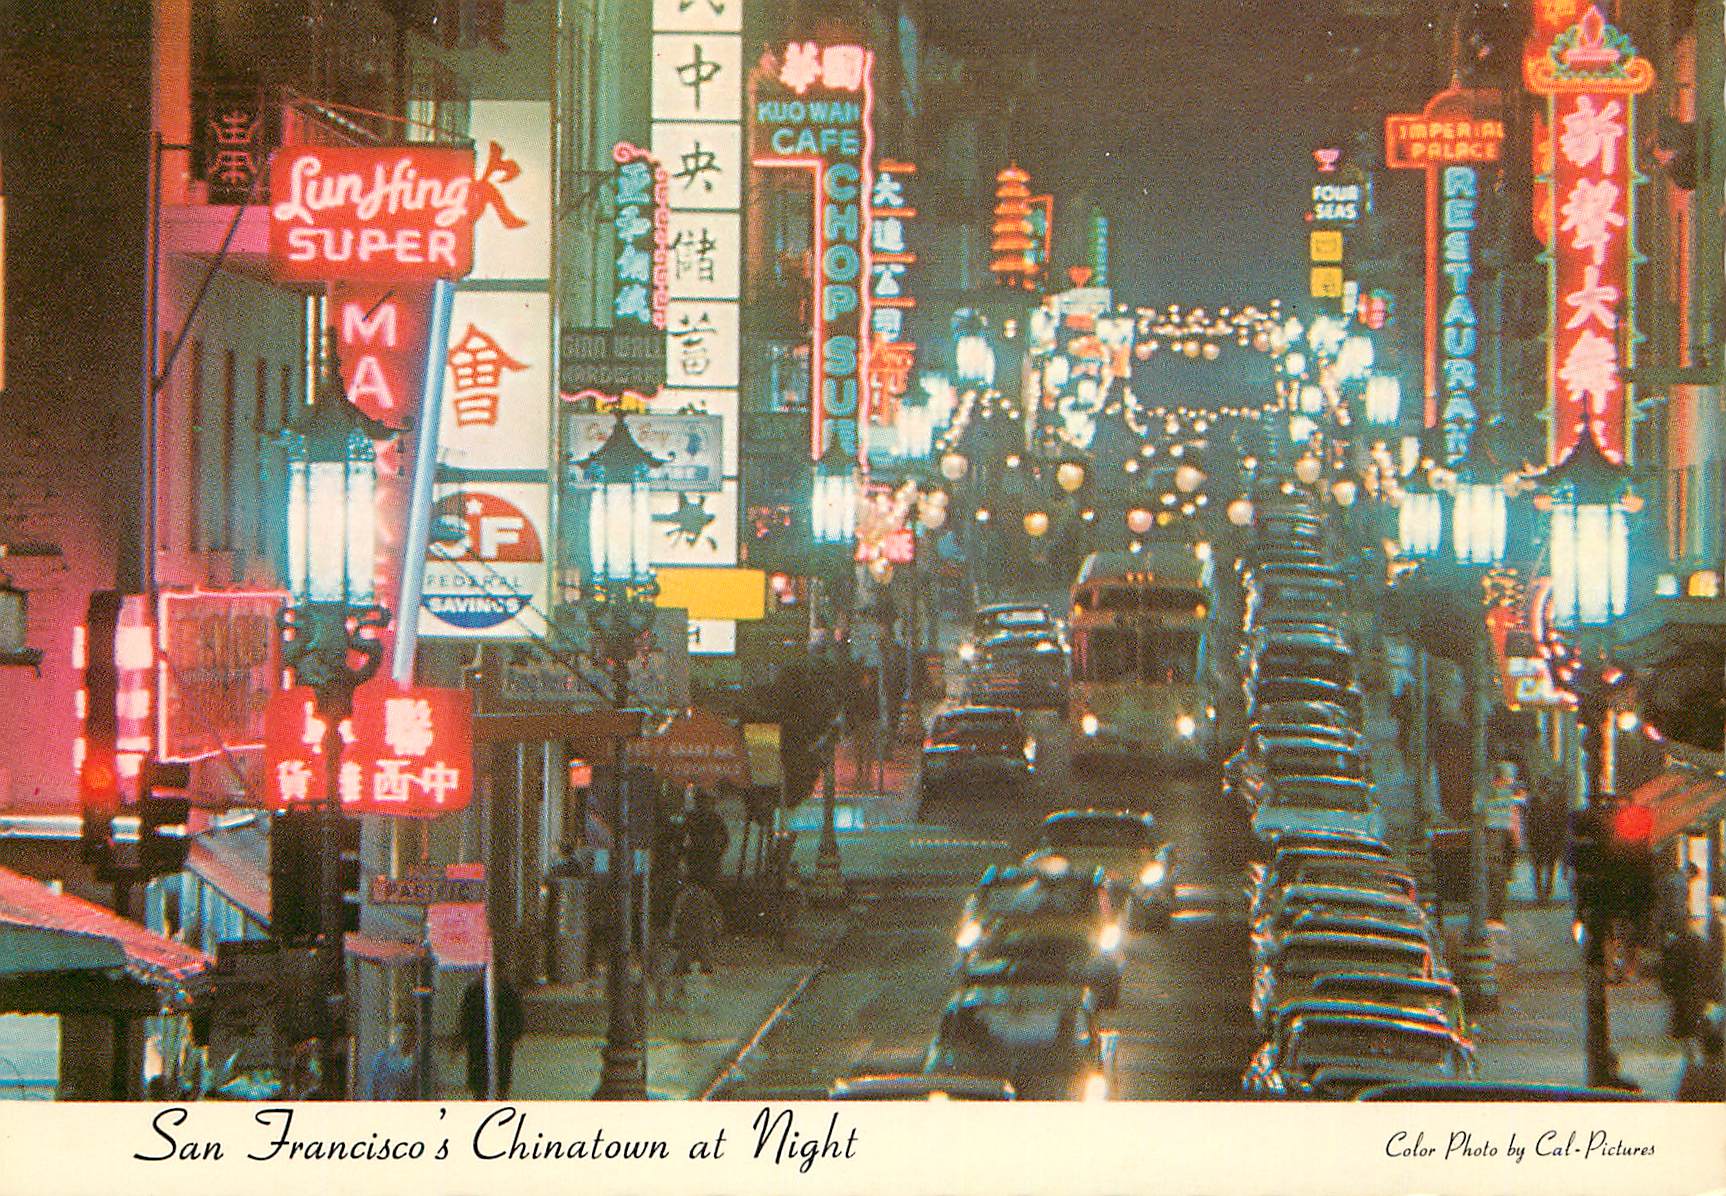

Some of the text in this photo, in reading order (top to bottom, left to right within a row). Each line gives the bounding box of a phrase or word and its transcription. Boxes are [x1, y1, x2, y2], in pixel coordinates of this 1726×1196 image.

[756, 100, 806, 124] KUO
[771, 127, 861, 156] CAFE
[1410, 141, 1497, 160] PALACE
[273, 156, 472, 227] Lun Hing
[1312, 185, 1360, 202] FOUR
[1315, 203, 1359, 219] SEAS
[287, 228, 458, 267] SUPER
[822, 163, 860, 321] CHOP
